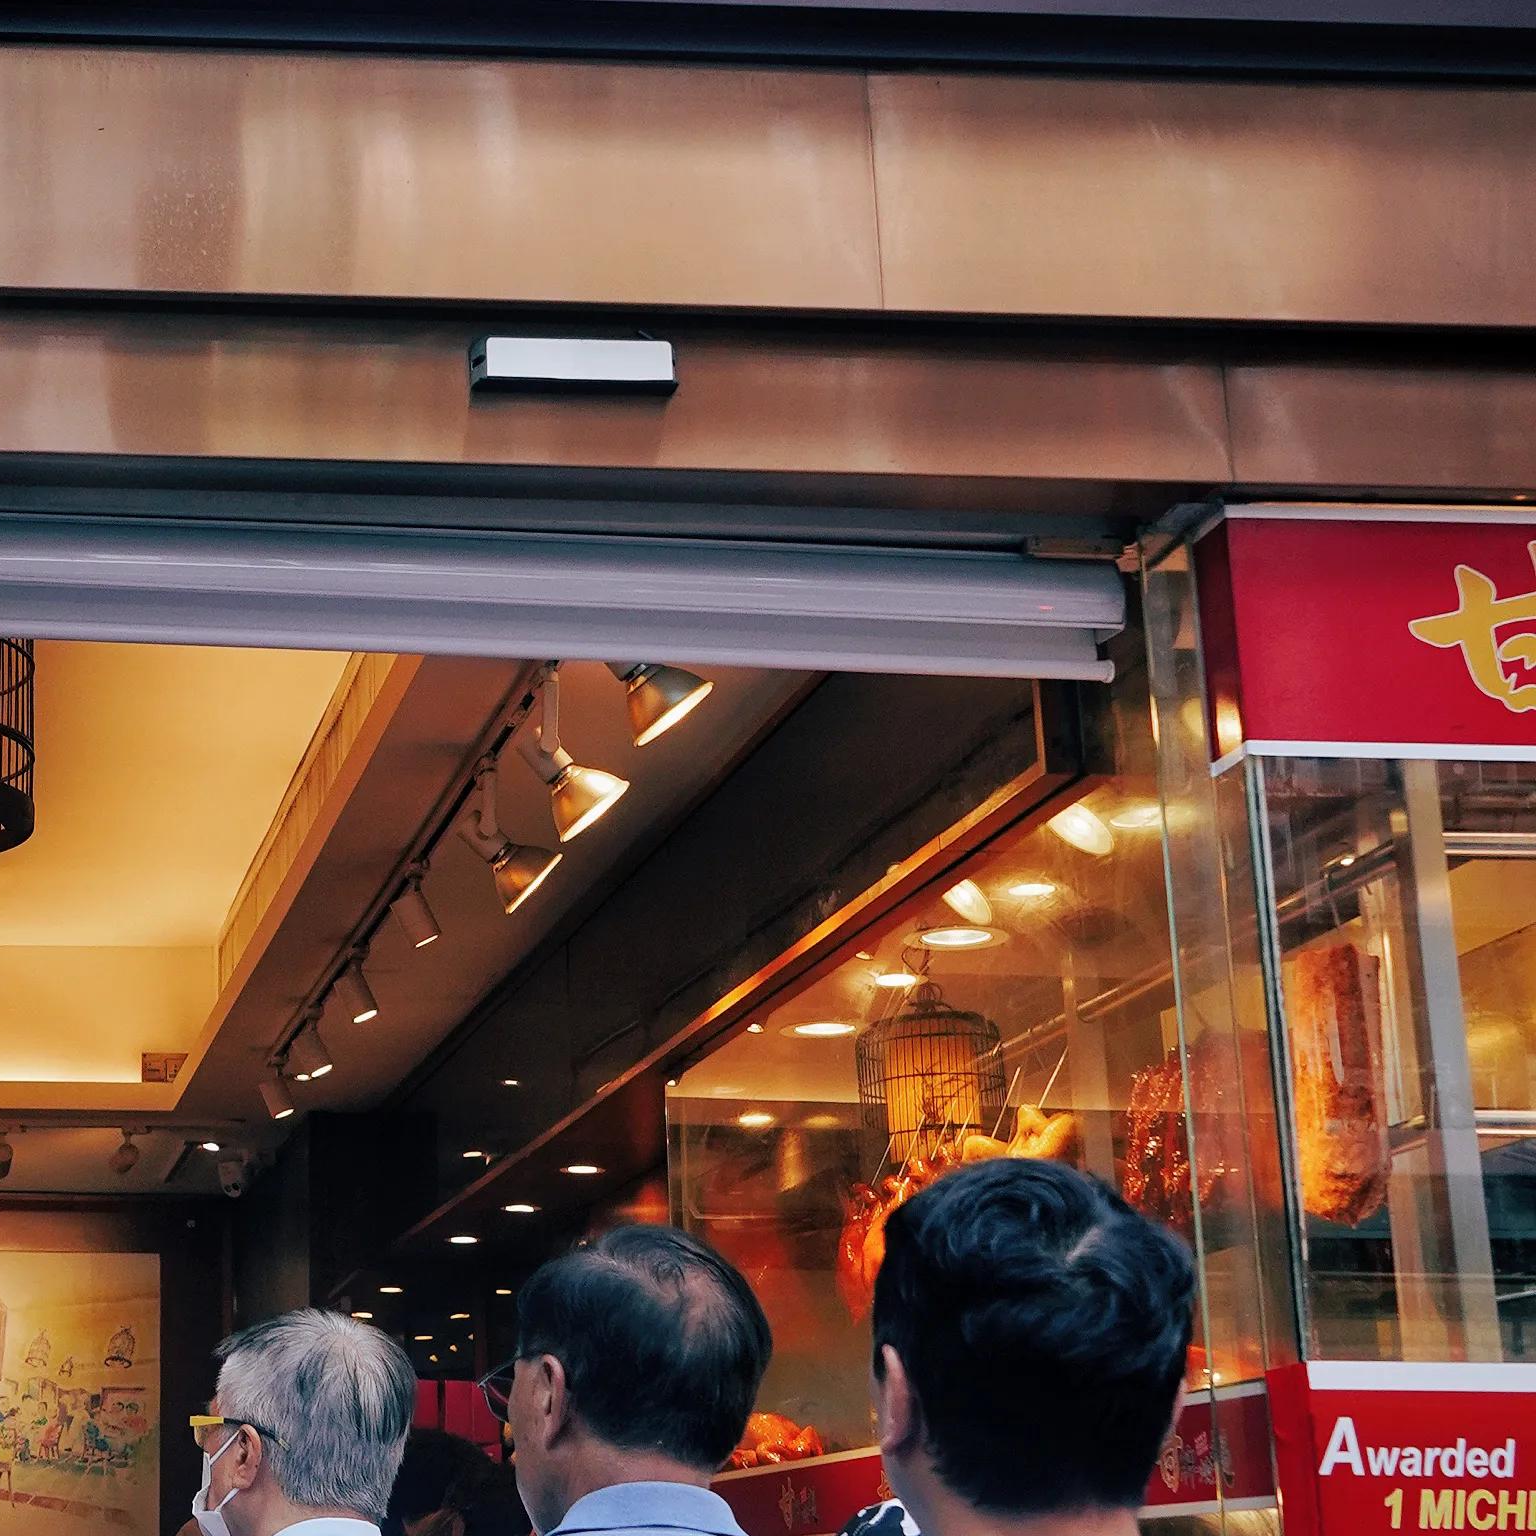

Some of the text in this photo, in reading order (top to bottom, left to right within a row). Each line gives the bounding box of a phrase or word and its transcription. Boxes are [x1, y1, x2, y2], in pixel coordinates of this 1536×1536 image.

[1318, 1416, 1517, 1479] Awarded
[1383, 1487, 1536, 1531] 1 MICH
